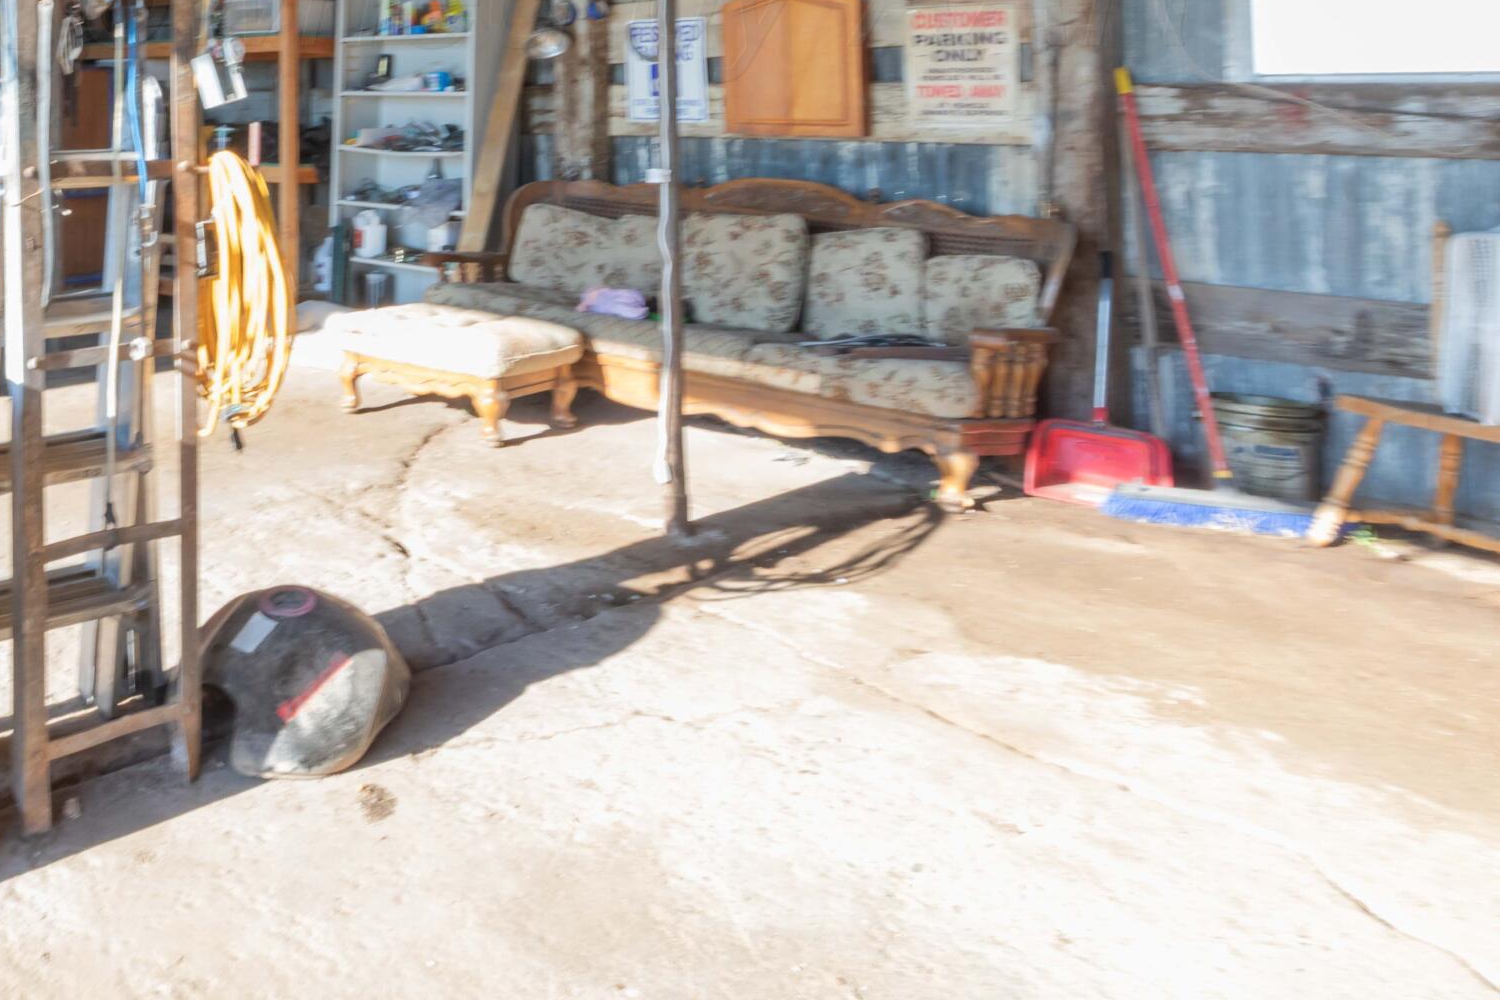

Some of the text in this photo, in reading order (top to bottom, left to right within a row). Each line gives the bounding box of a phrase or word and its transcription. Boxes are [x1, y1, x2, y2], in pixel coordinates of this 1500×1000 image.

[911, 11, 1006, 29] CUSTOMER
[913, 31, 1007, 46] PARKING
[932, 48, 986, 62] ONLY
[916, 85, 1007, 99] TOWED AWAY
